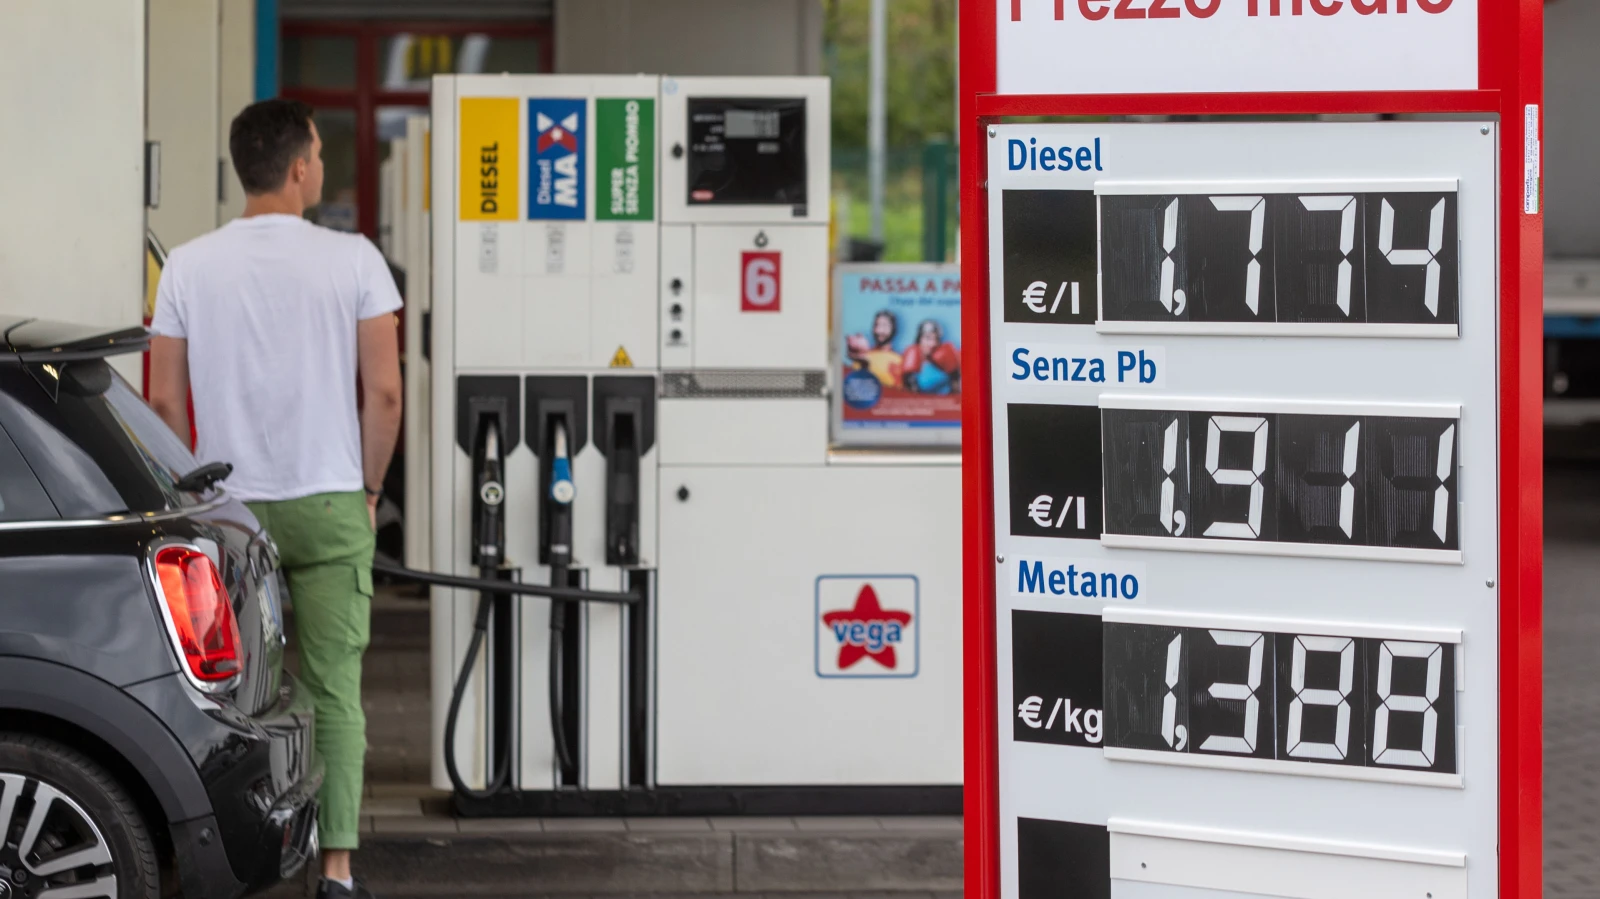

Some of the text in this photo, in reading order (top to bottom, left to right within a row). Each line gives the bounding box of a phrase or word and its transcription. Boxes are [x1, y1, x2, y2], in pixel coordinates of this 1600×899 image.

[480, 142, 498, 214] DIESEL
[537, 112, 578, 207] MAX
[626, 101, 639, 215] SENZA PIOMBO
[1008, 137, 1103, 172] Diesel
[537, 159, 551, 205] Diesel
[611, 168, 624, 215] SUPER
[1160, 195, 1445, 317] 1,774
[744, 258, 777, 306] 6
[860, 278, 919, 293] PASSA
[926, 279, 937, 292] A
[1011, 347, 1157, 385] Senza Pb
[1160, 415, 1455, 544] 1,911
[1018, 560, 1139, 600] Metano
[833, 620, 902, 650] vega
[1018, 629, 1443, 768] €/kg 1,388
